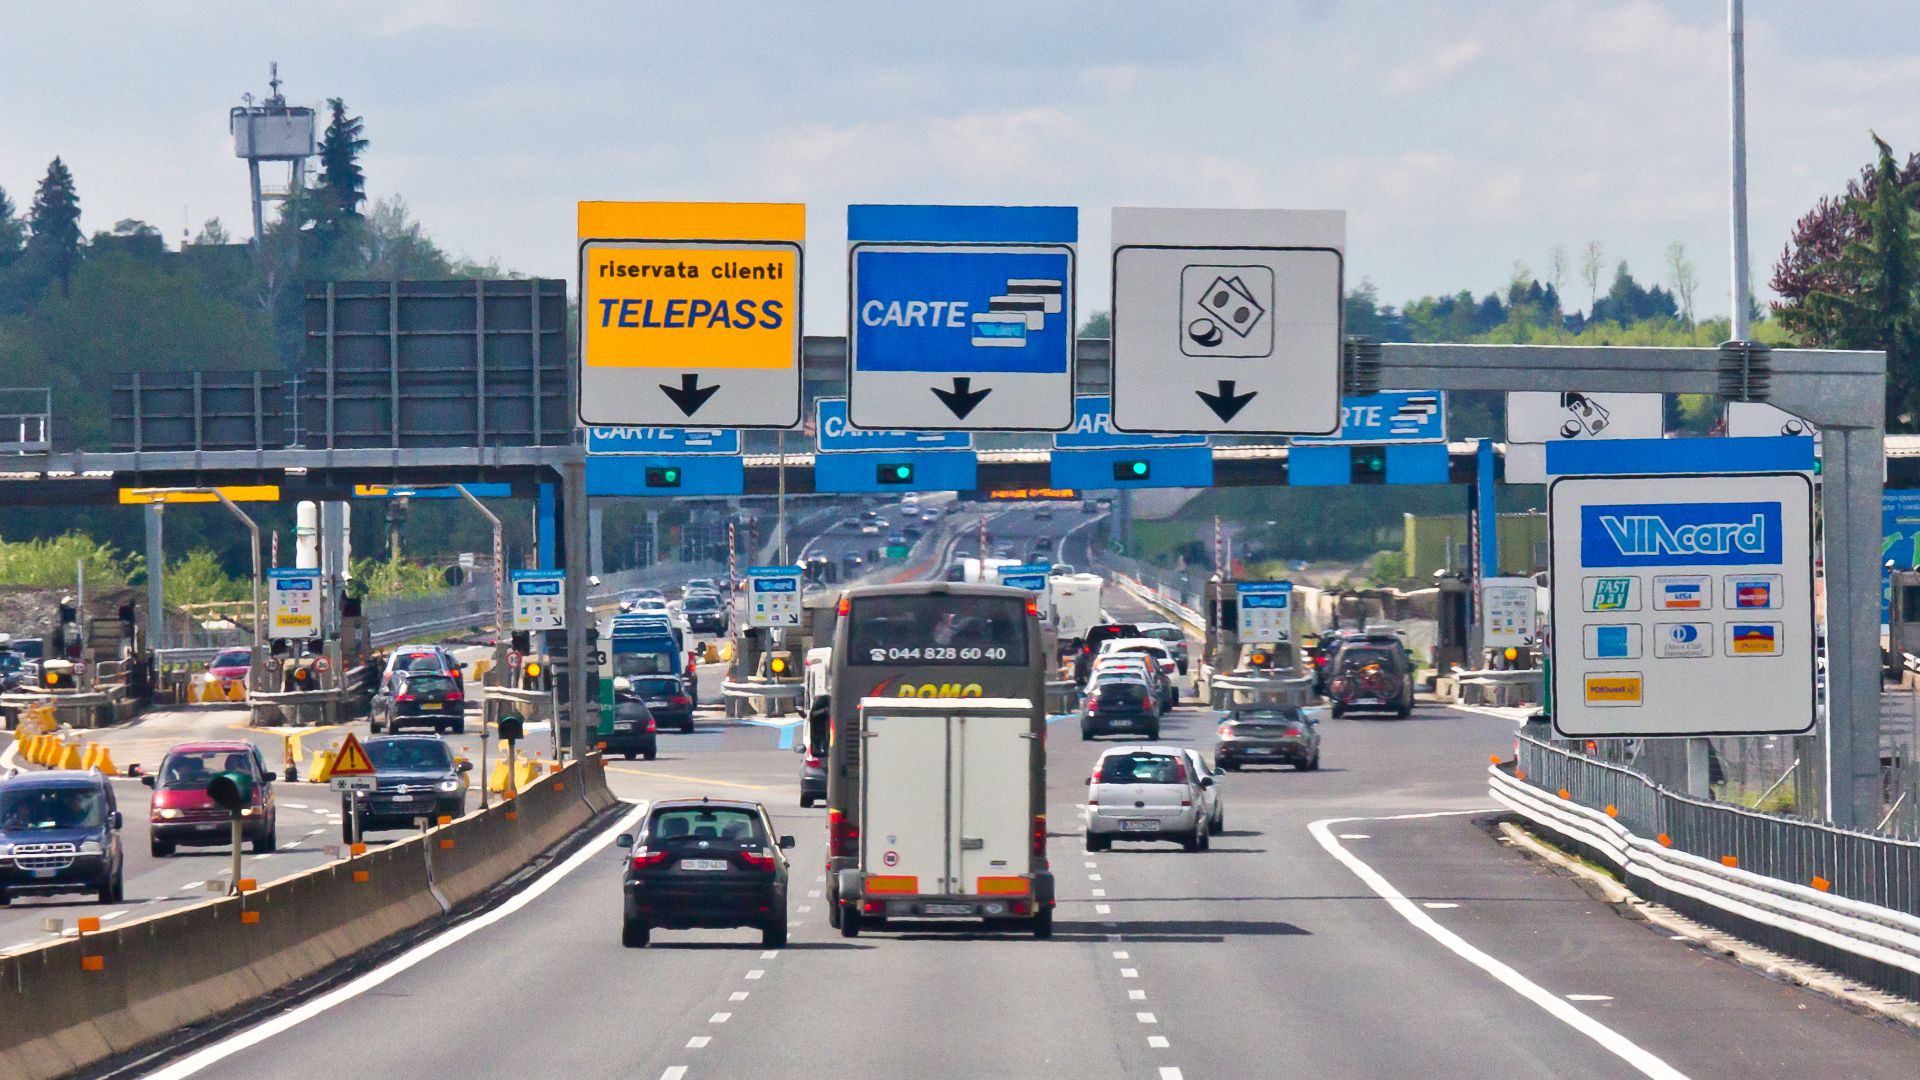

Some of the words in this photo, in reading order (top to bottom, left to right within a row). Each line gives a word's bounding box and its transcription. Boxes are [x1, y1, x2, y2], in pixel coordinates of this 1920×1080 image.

[599, 260, 699, 279] riservata
[711, 262, 784, 280] clienti
[598, 298, 784, 330] TELEPASS
[861, 299, 969, 328] CARTE
[1598, 580, 1628, 594] FAST
[1595, 593, 1625, 608] pay
[888, 647, 920, 660] 044
[923, 647, 957, 660] 828
[960, 647, 981, 660] 60
[984, 647, 1007, 660] 40
